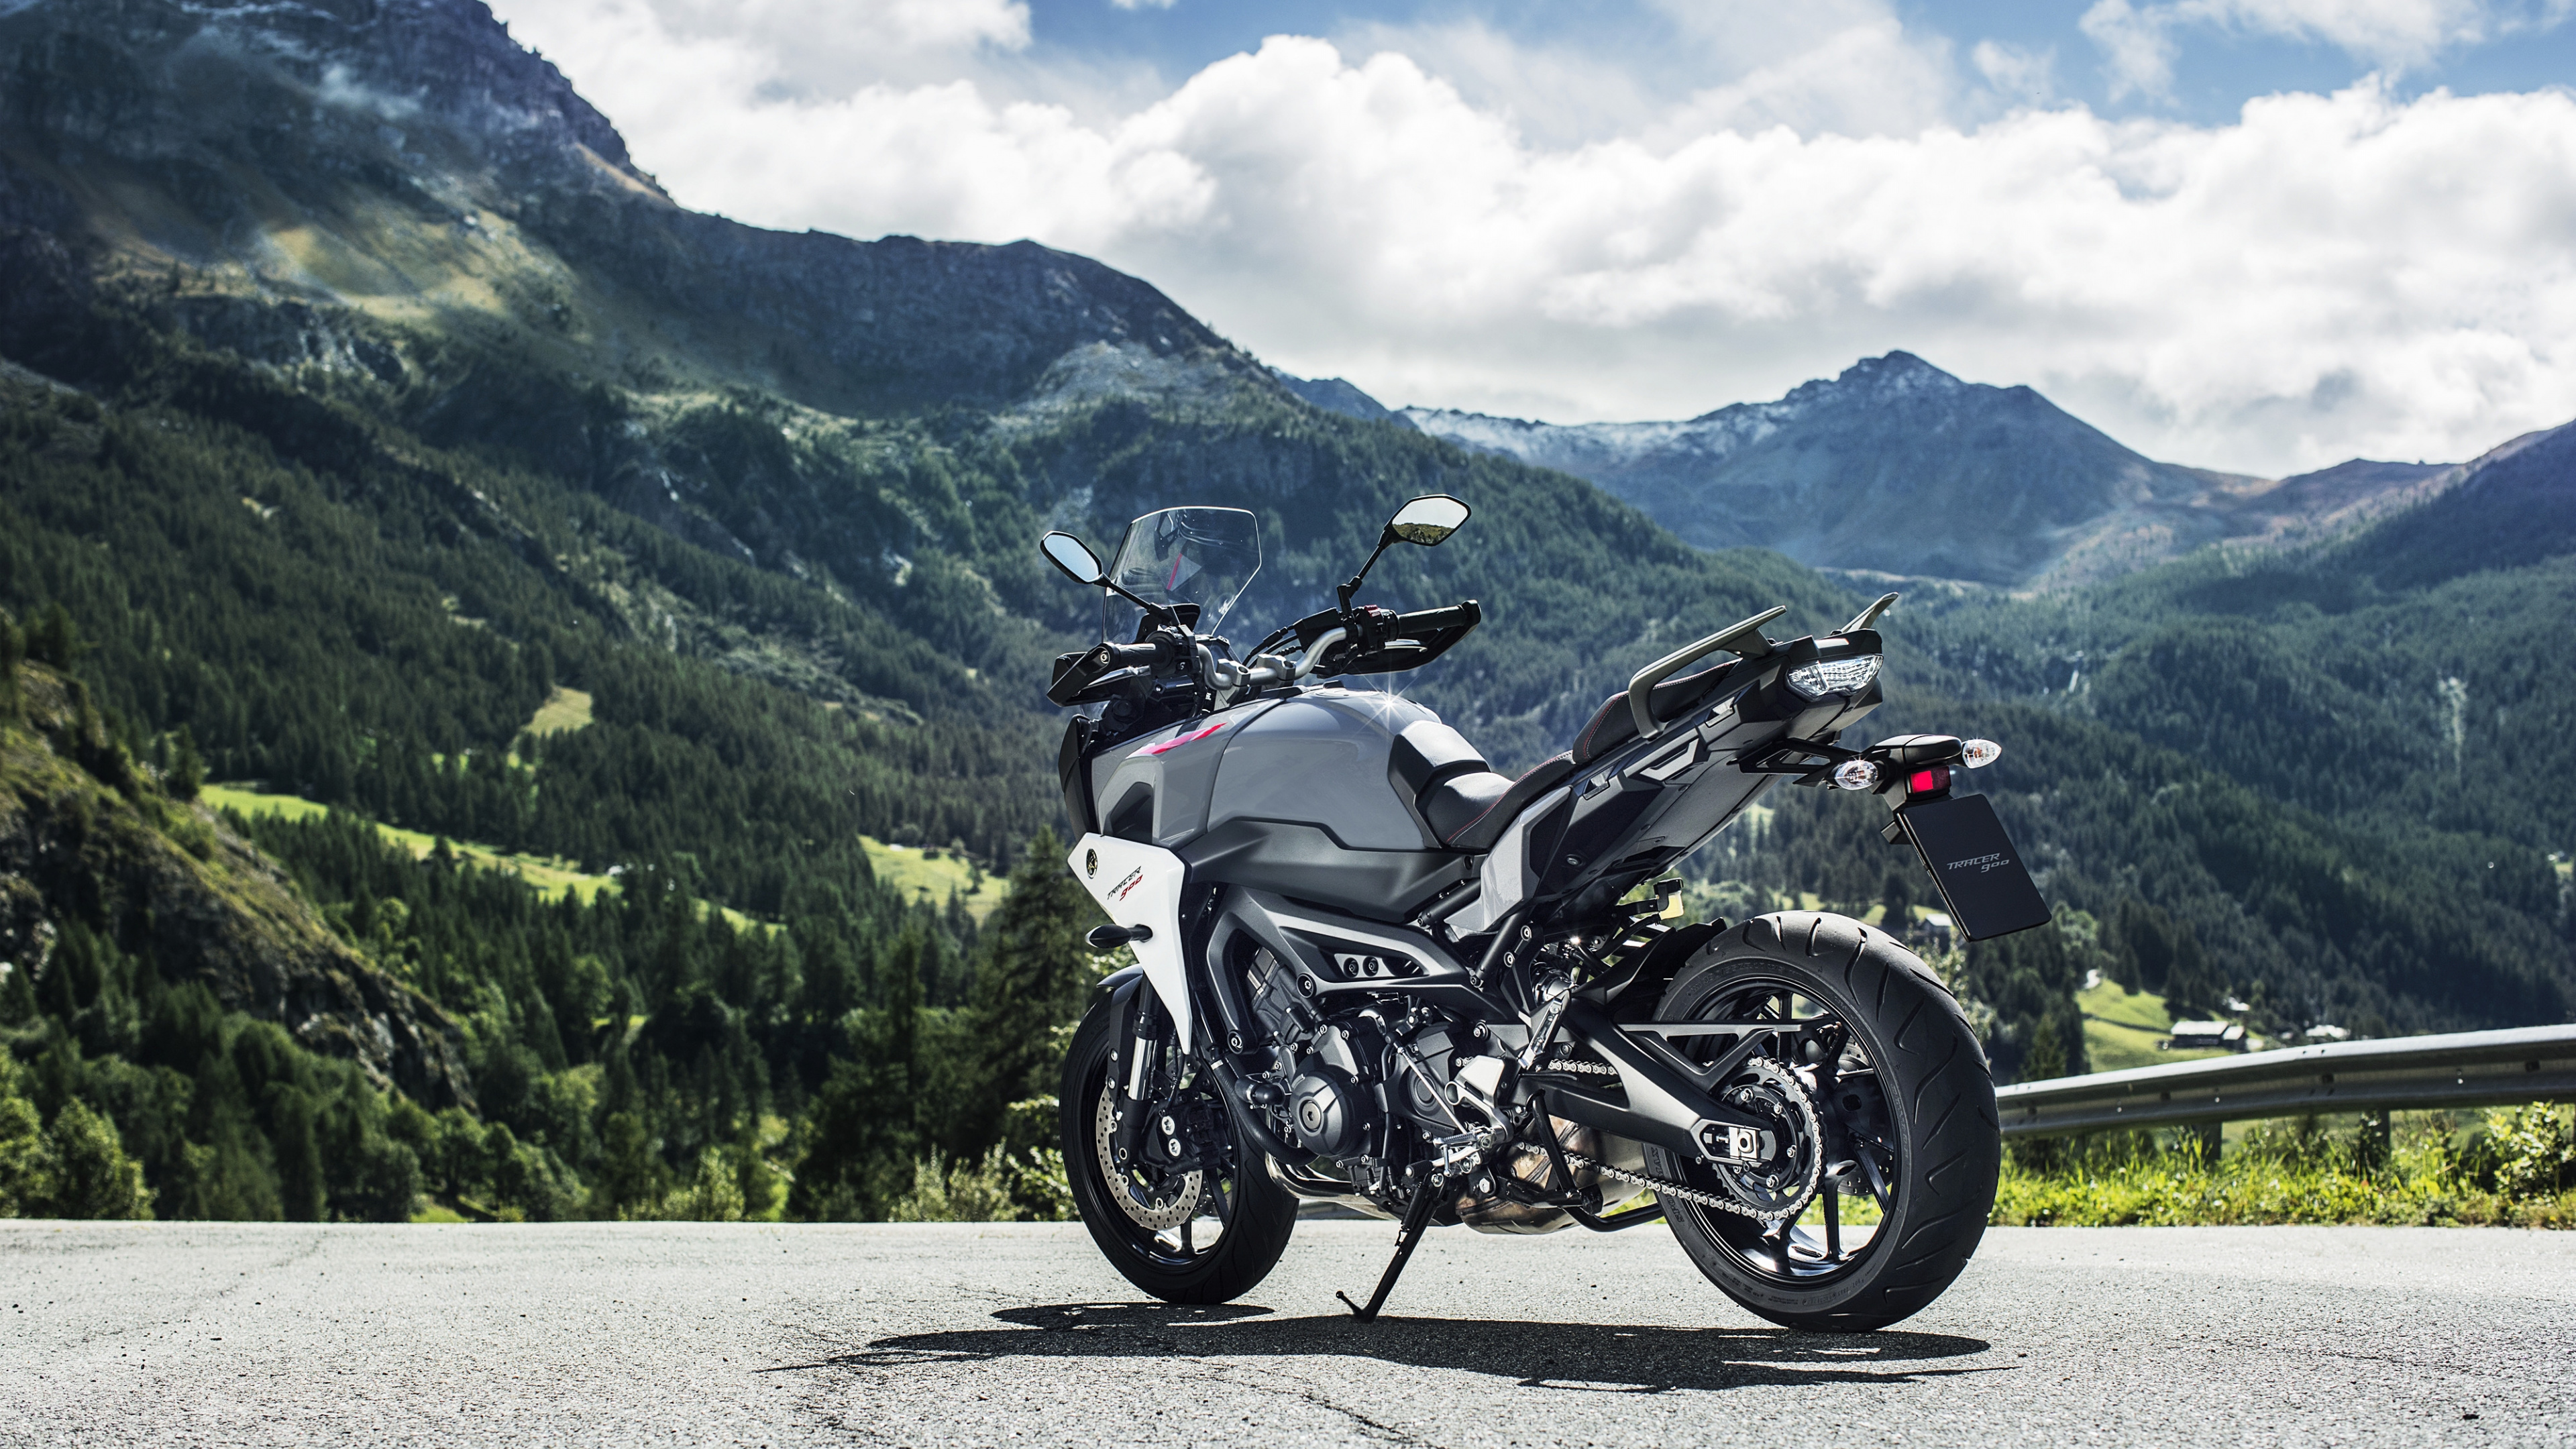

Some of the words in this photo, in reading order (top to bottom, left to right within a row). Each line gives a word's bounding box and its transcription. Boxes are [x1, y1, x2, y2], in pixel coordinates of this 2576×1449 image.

[1947, 853, 2000, 870] TRACER
[1980, 859, 2010, 873] 900
[1107, 865, 1142, 900] TRACER
[1119, 874, 1144, 902] 900
